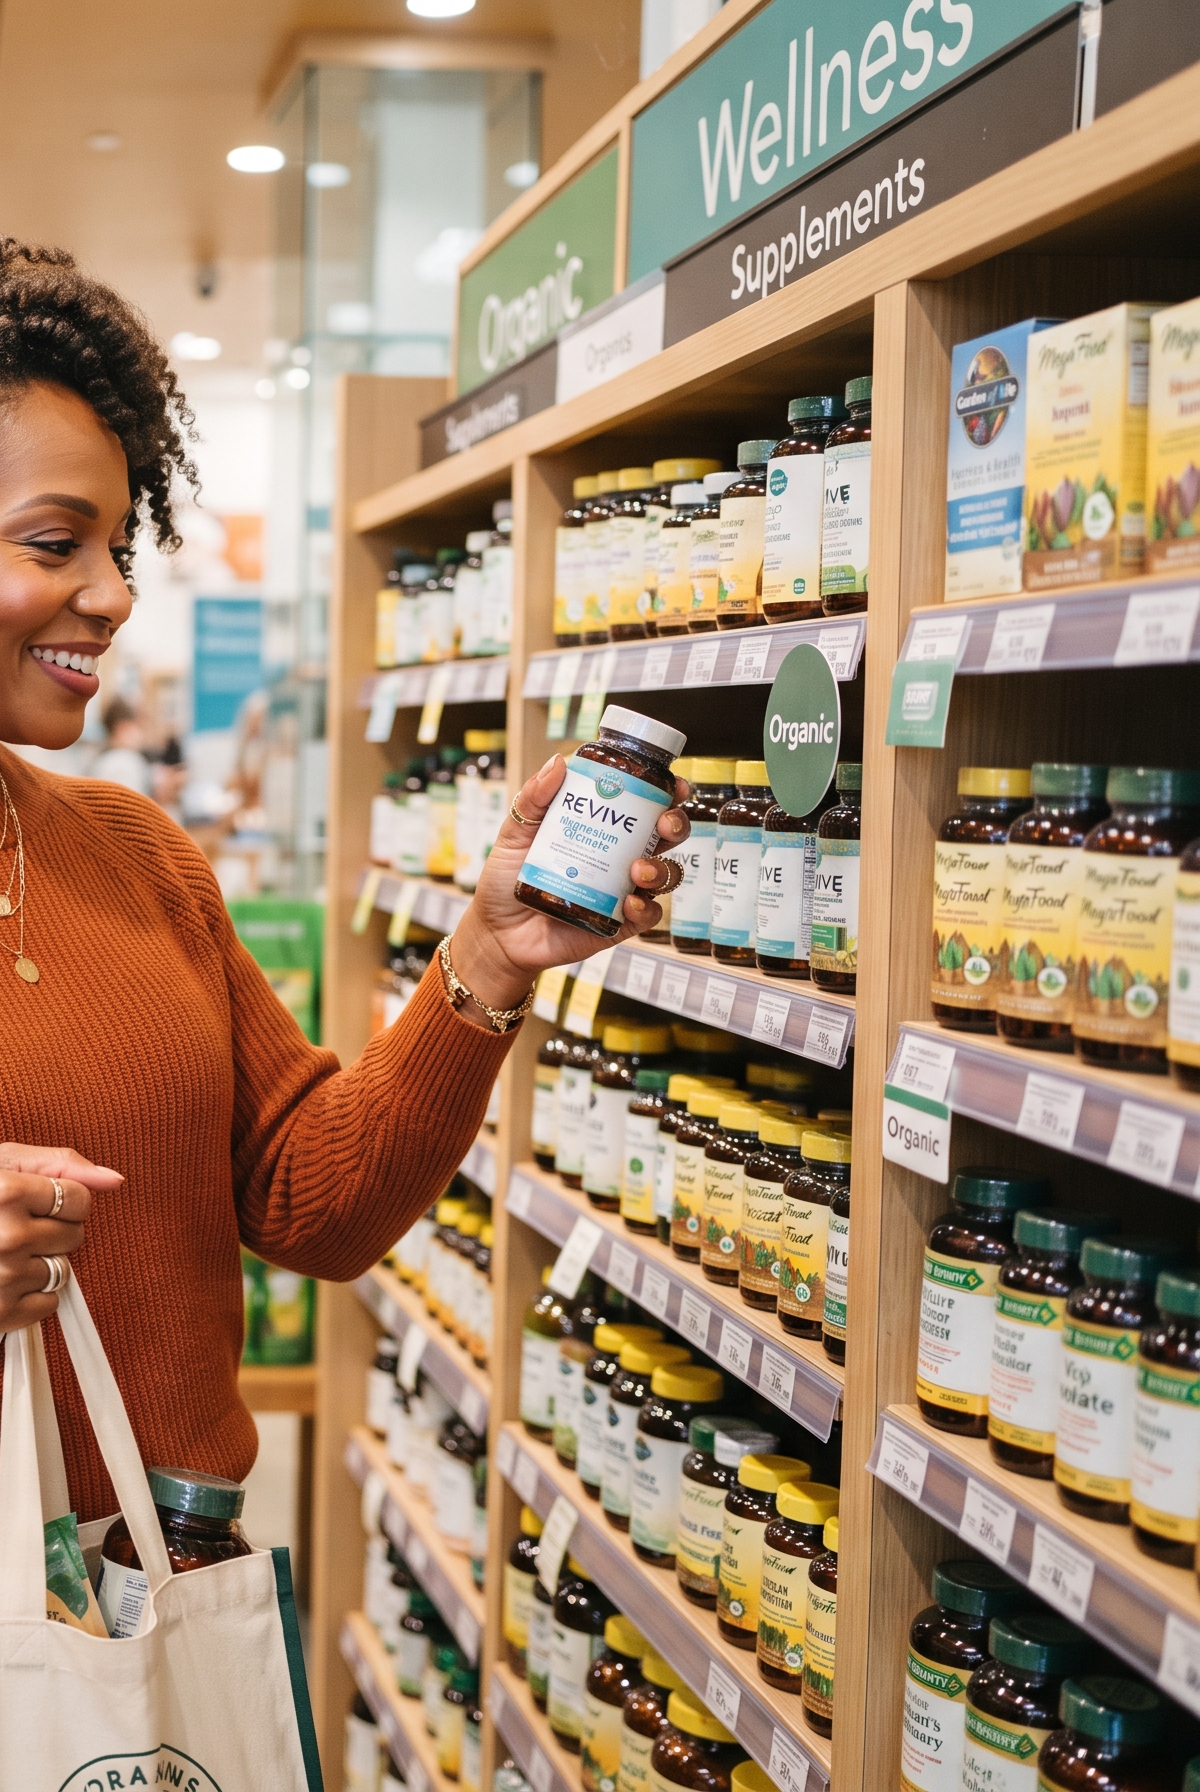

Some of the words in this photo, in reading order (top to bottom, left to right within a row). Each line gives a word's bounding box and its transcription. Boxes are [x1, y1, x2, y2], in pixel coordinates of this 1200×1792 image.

[698, 0, 974, 218] Wellness
[731, 158, 926, 300] Supplements
[478, 240, 584, 372] Organic
[769, 714, 834, 751] Organic
[562, 792, 638, 834] REVIVE
[888, 1116, 940, 1156] Organic
